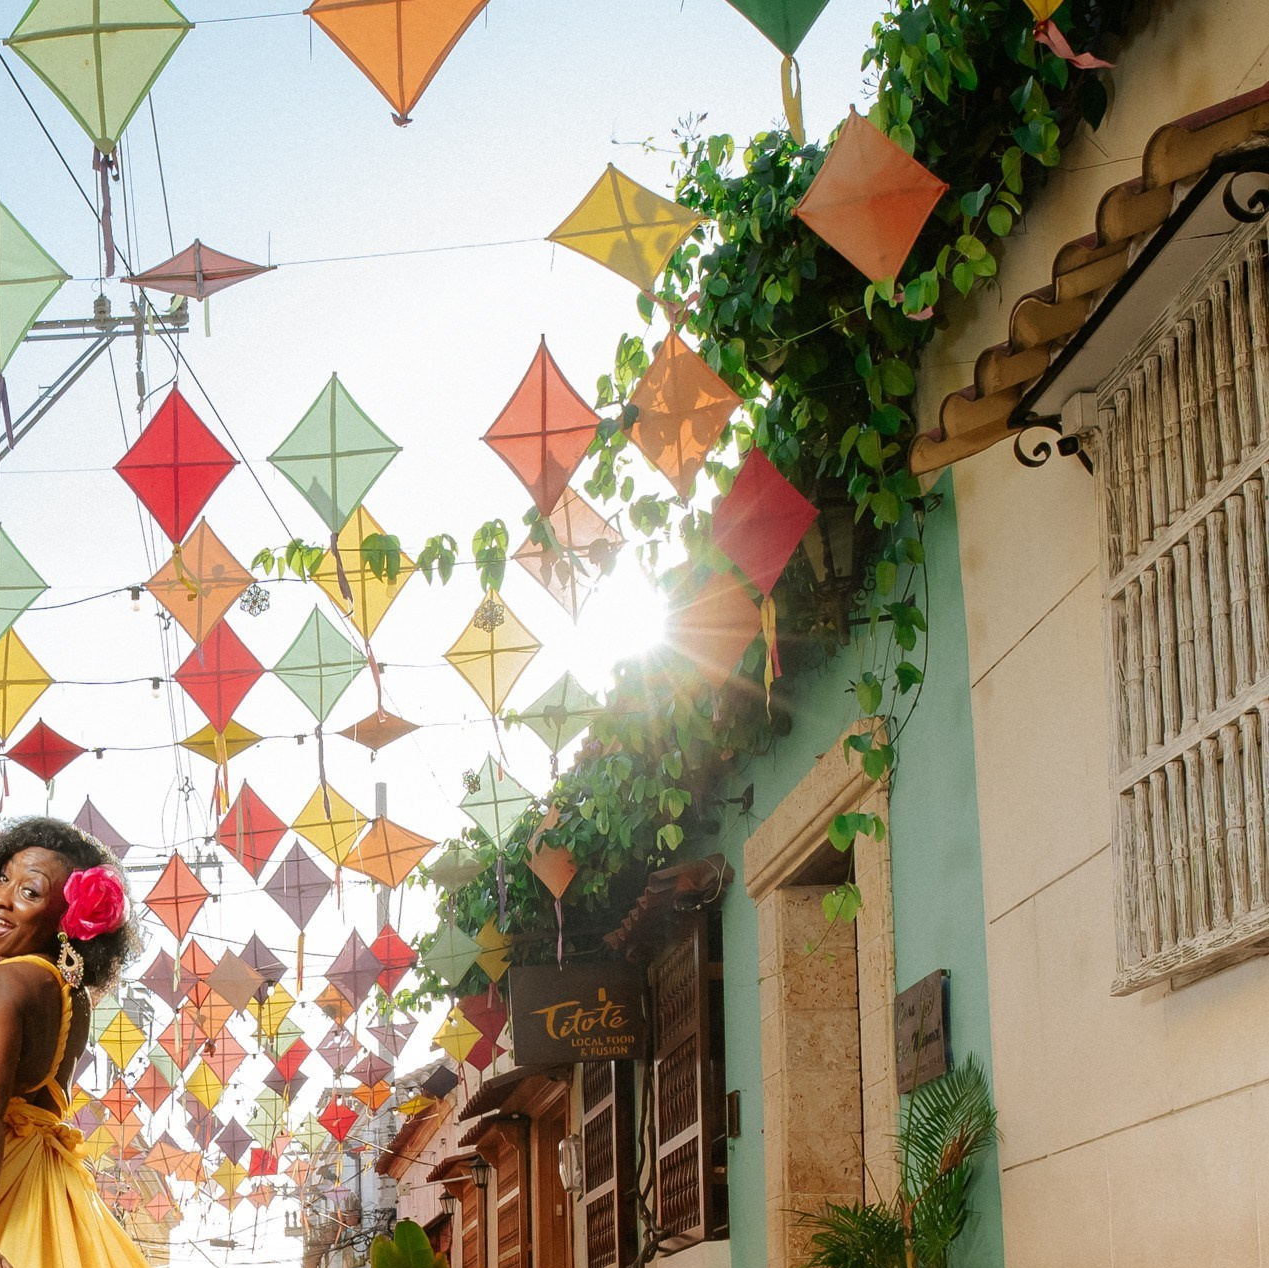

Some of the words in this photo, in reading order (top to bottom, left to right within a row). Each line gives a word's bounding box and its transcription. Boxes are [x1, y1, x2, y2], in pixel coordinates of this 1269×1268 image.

[530, 1000, 629, 1040] Titoté
[571, 1036, 604, 1047] LOCAL
[606, 1034, 635, 1044] FOOD
[580, 1047, 588, 1057] &
[590, 1045, 628, 1056] FUSION
